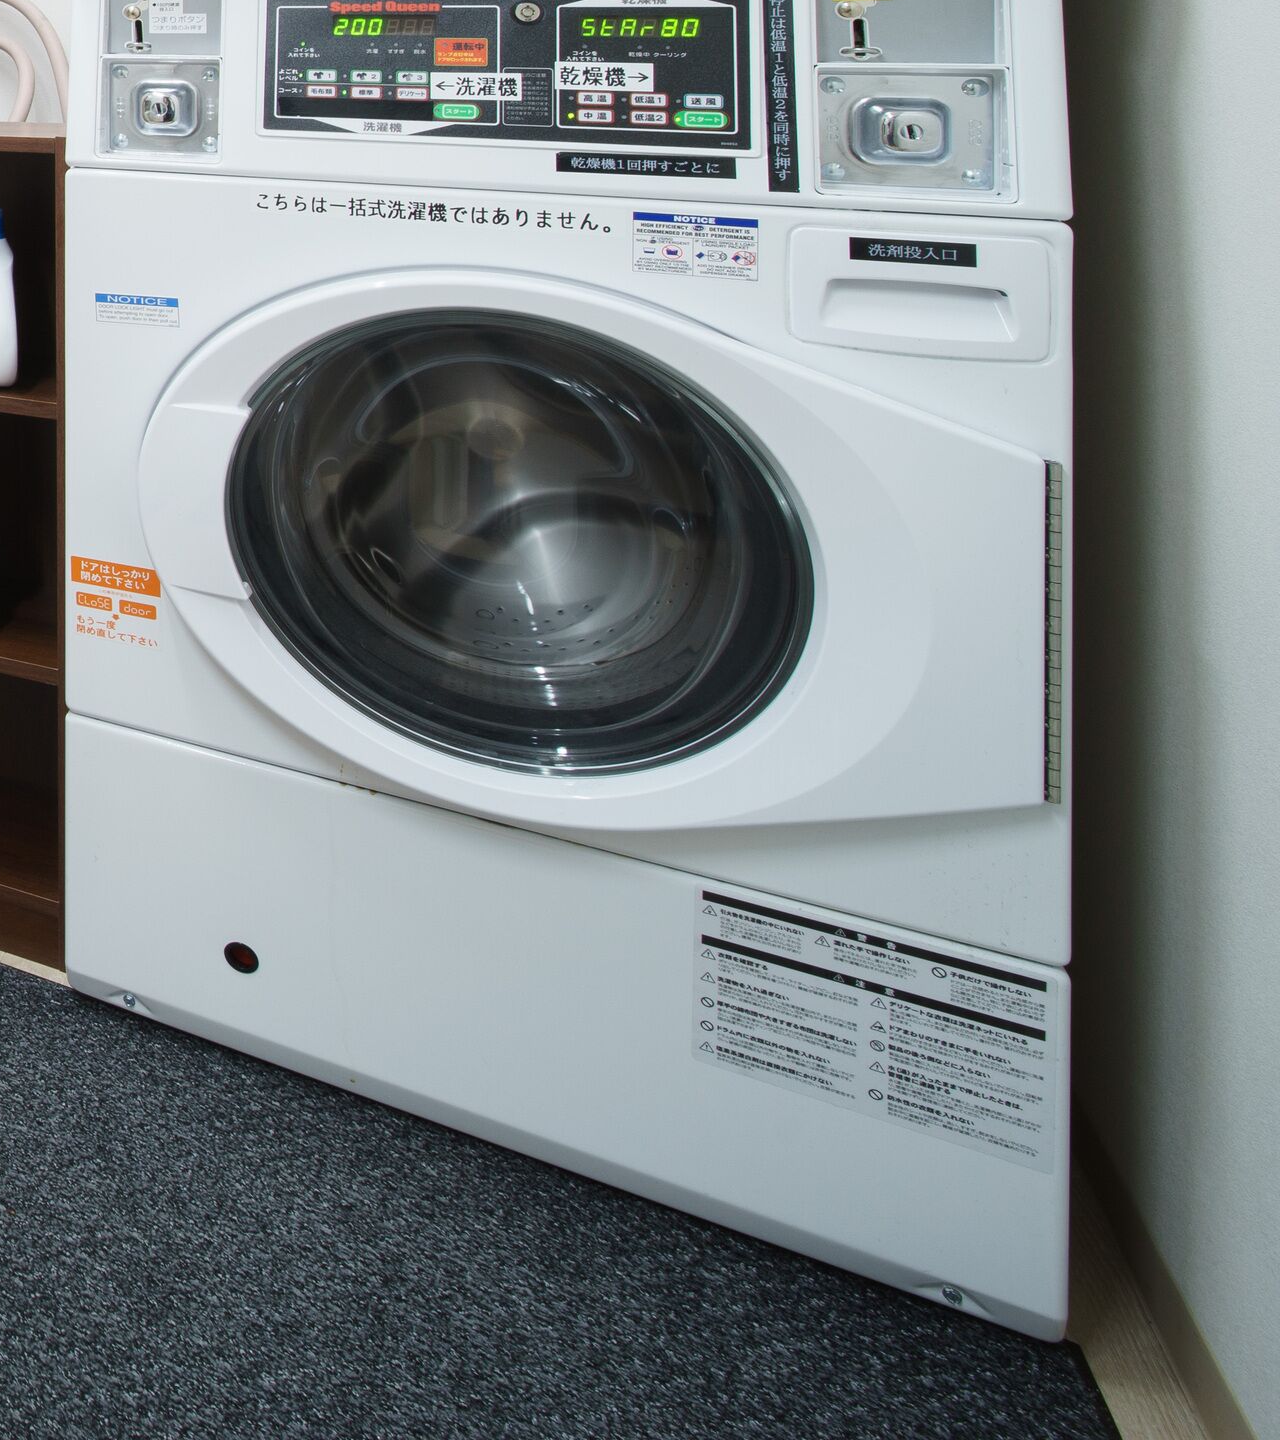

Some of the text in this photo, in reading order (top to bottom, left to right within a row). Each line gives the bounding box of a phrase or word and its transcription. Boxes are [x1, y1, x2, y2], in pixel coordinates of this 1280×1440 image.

[330, 0, 440, 15] Speed Queen
[152, 14, 205, 24] つまりボタン
[334, 18, 383, 36] 200
[452, 42, 485, 51] 運転中
[560, 66, 626, 87] 乾燥機
[456, 77, 518, 97] 洗濯機
[583, 94, 607, 103] 高温
[634, 95, 662, 104] 低温1
[691, 97, 717, 106] 送風
[583, 112, 607, 120] 中温
[634, 114, 663, 122] 低温2
[363, 122, 403, 133] 洗濯機
[570, 156, 721, 174] 乾燥機1回押すごとに
[255, 193, 615, 235] こちらは一括式洗濯機ではありません。
[673, 215, 716, 224] NOTICE
[710, 233, 754, 241] PERFORMANCE
[868, 243, 957, 261] 洗剤投入口
[107, 295, 168, 306] NOTICE
[80, 560, 150, 581] ドアはしっかり
[80, 570, 145, 590] 閉めて下さい
[123, 604, 152, 616] door
[76, 614, 116, 630] もう一度
[76, 624, 158, 647] 閉め直して下さい
[718, 952, 768, 970] 衣類を確認する
[949, 971, 1032, 998] 子供だけで操作しない
[889, 1001, 1028, 1045] デリケートな衣類は洗濯ネットにいれる
[717, 1025, 831, 1064] ドラム内に衣類以外の物を入れない
[889, 1025, 1011, 1064] ドアまわりのすきまに手をいれない
[888, 1044, 991, 1079] 製品の後ろ側などに入らない
[887, 1094, 975, 1126] 防水性の衣類を入れない
